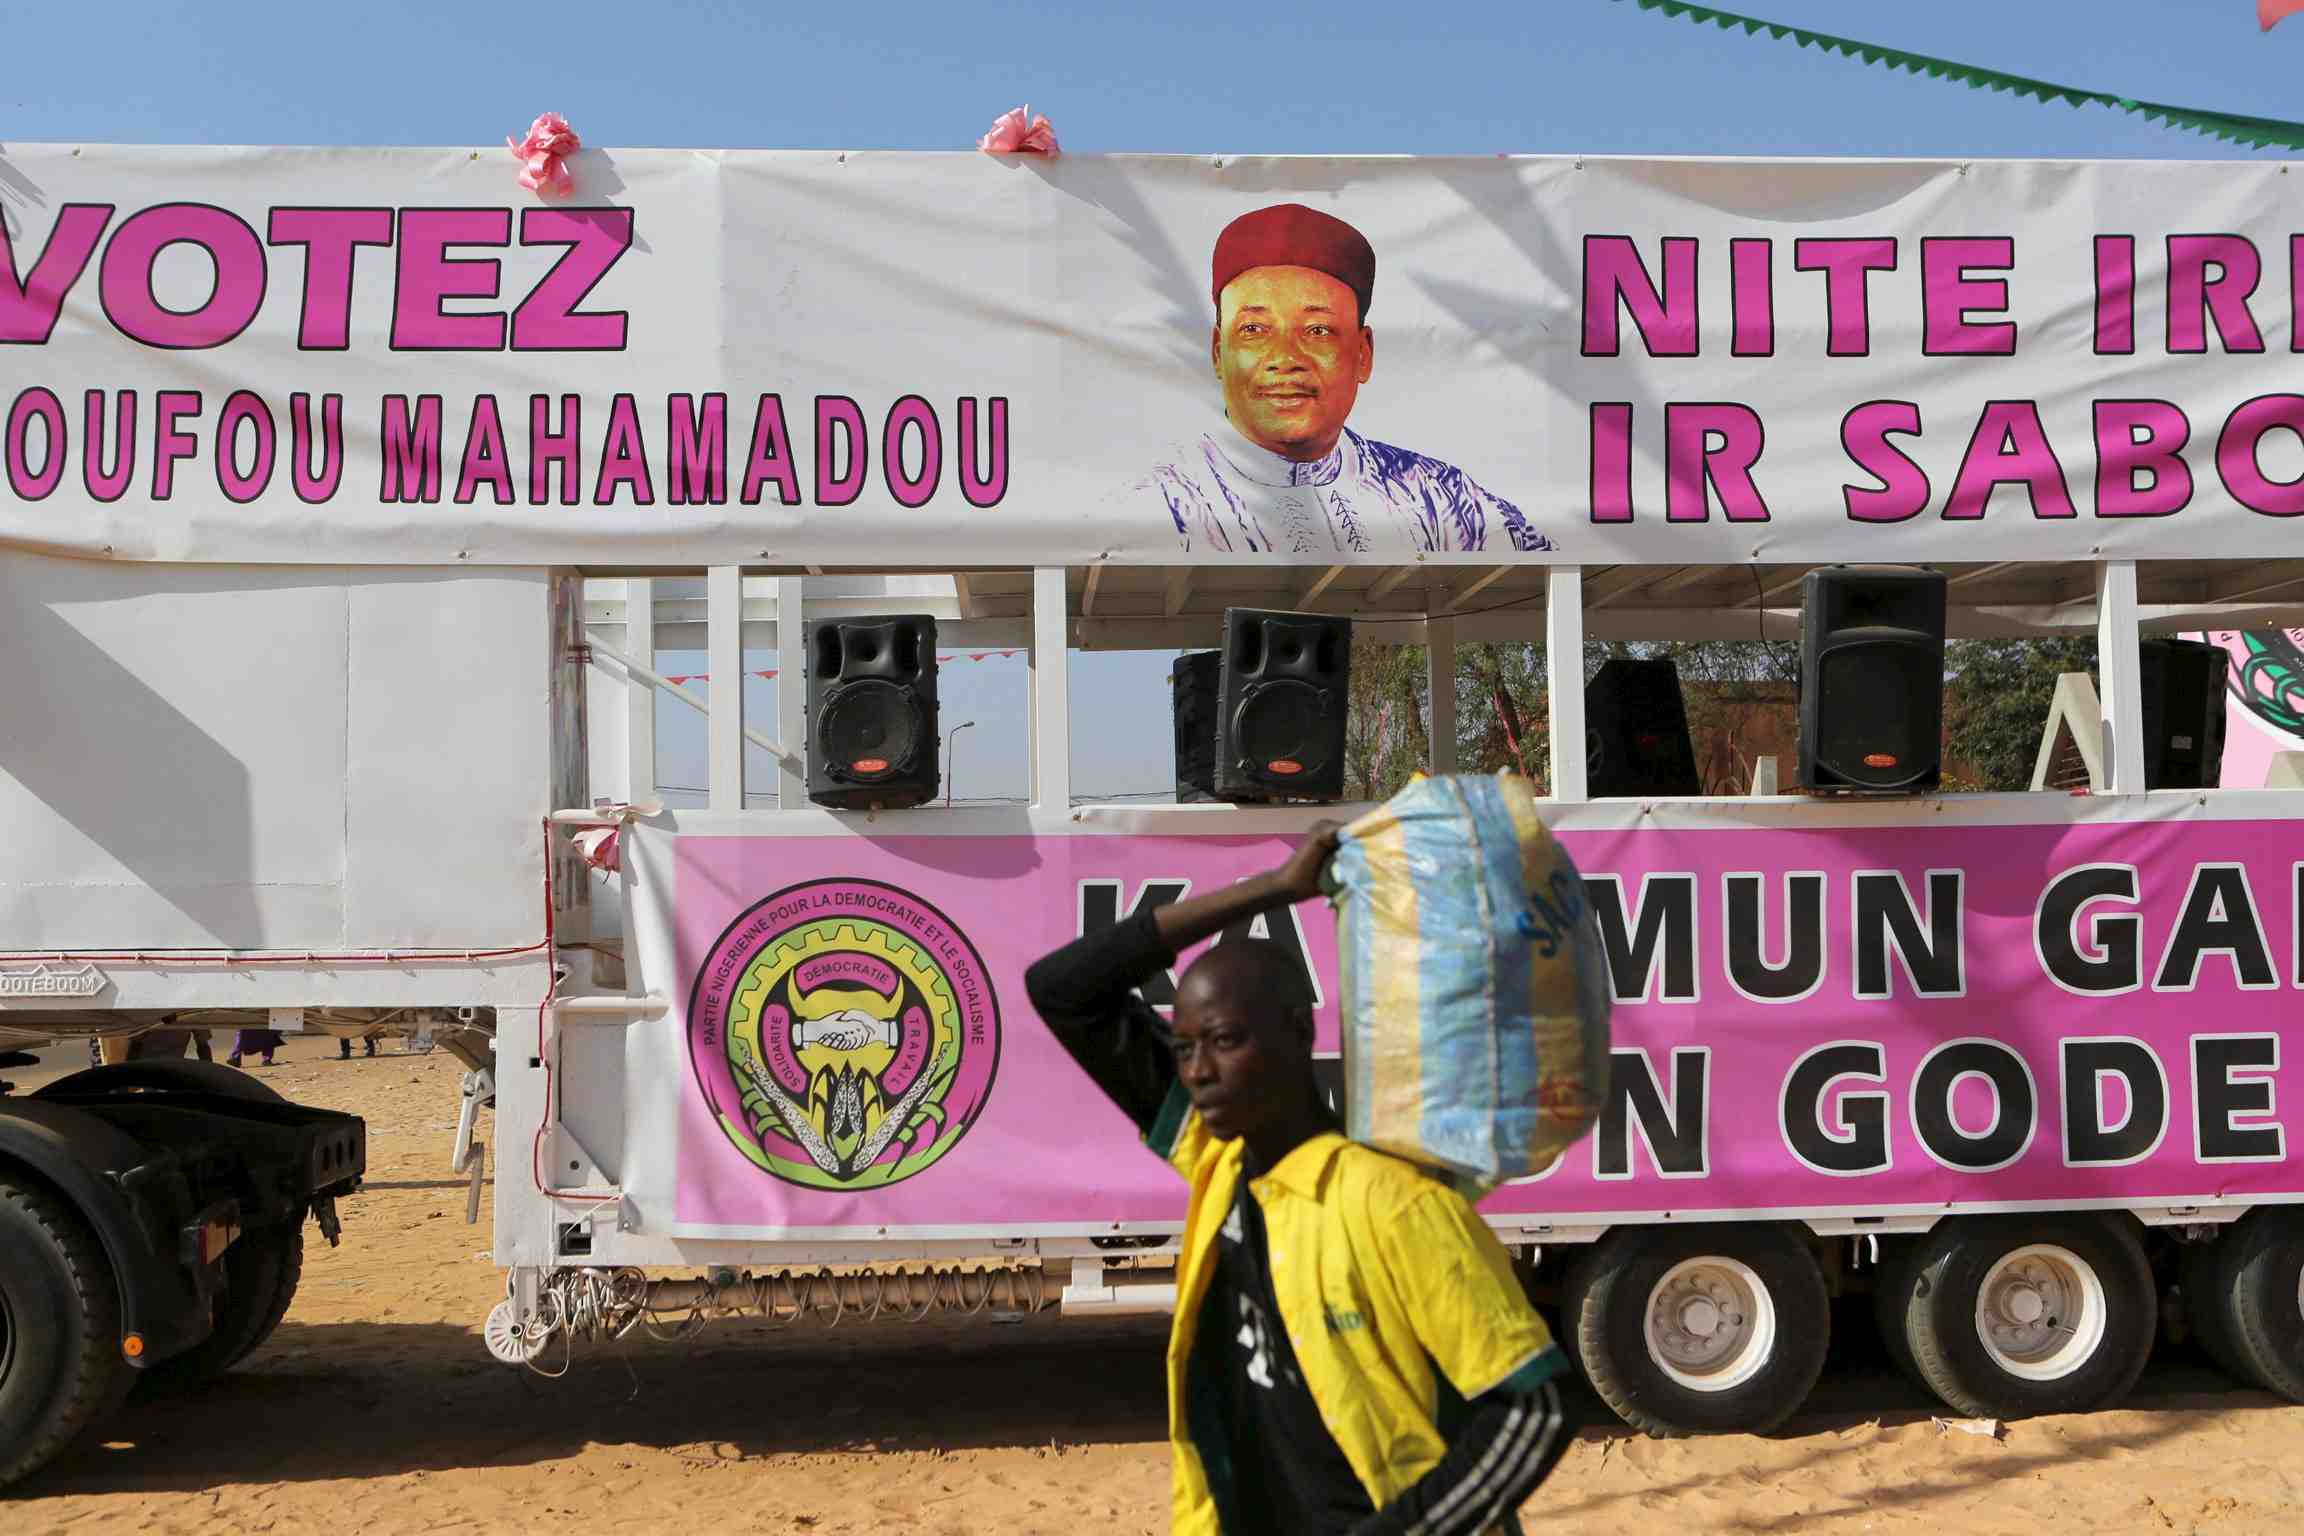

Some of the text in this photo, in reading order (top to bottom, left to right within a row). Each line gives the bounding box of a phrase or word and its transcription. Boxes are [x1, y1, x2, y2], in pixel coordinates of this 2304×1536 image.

[0, 202, 635, 351] VOTEZ
[1580, 235, 2018, 358] NITE
[5, 386, 1009, 507] OUFOU MAHAMADOU
[1590, 393, 2304, 523] IR SABO
[704, 892, 984, 1047] PARTIE NIGERIENNE POUR LA DEMOCRATIE ET LE SOCIALISME
[804, 961, 889, 984] DEMOCRATIE
[1577, 869, 1965, 1004] MUN
[2033, 861, 2304, 997] GA
[769, 1015, 801, 1088] SOLIDARITE
[1779, 1032, 2287, 1177] GODE
